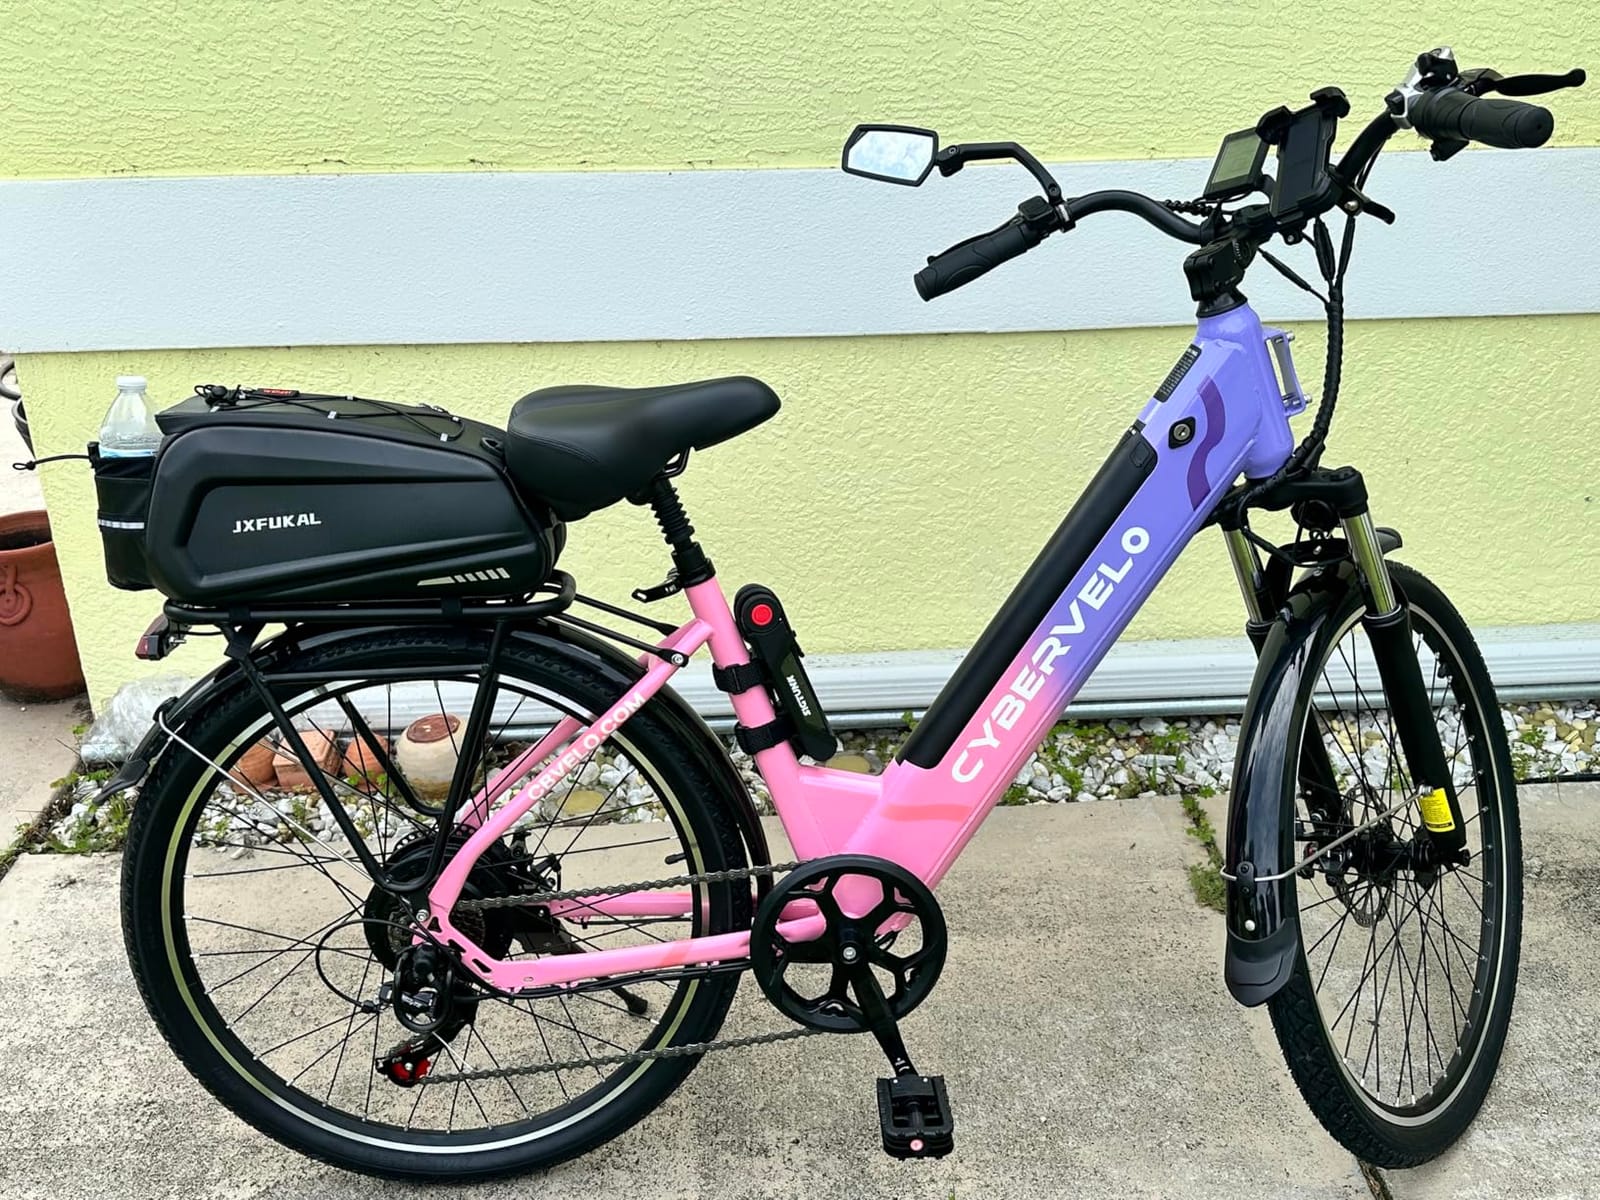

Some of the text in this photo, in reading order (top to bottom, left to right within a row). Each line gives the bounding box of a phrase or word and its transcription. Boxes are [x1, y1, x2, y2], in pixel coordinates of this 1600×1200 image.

[232, 512, 322, 533] JXFUKAL
[951, 526, 1150, 783] CYBERVELO
[527, 691, 647, 800] CBVELO.COM
